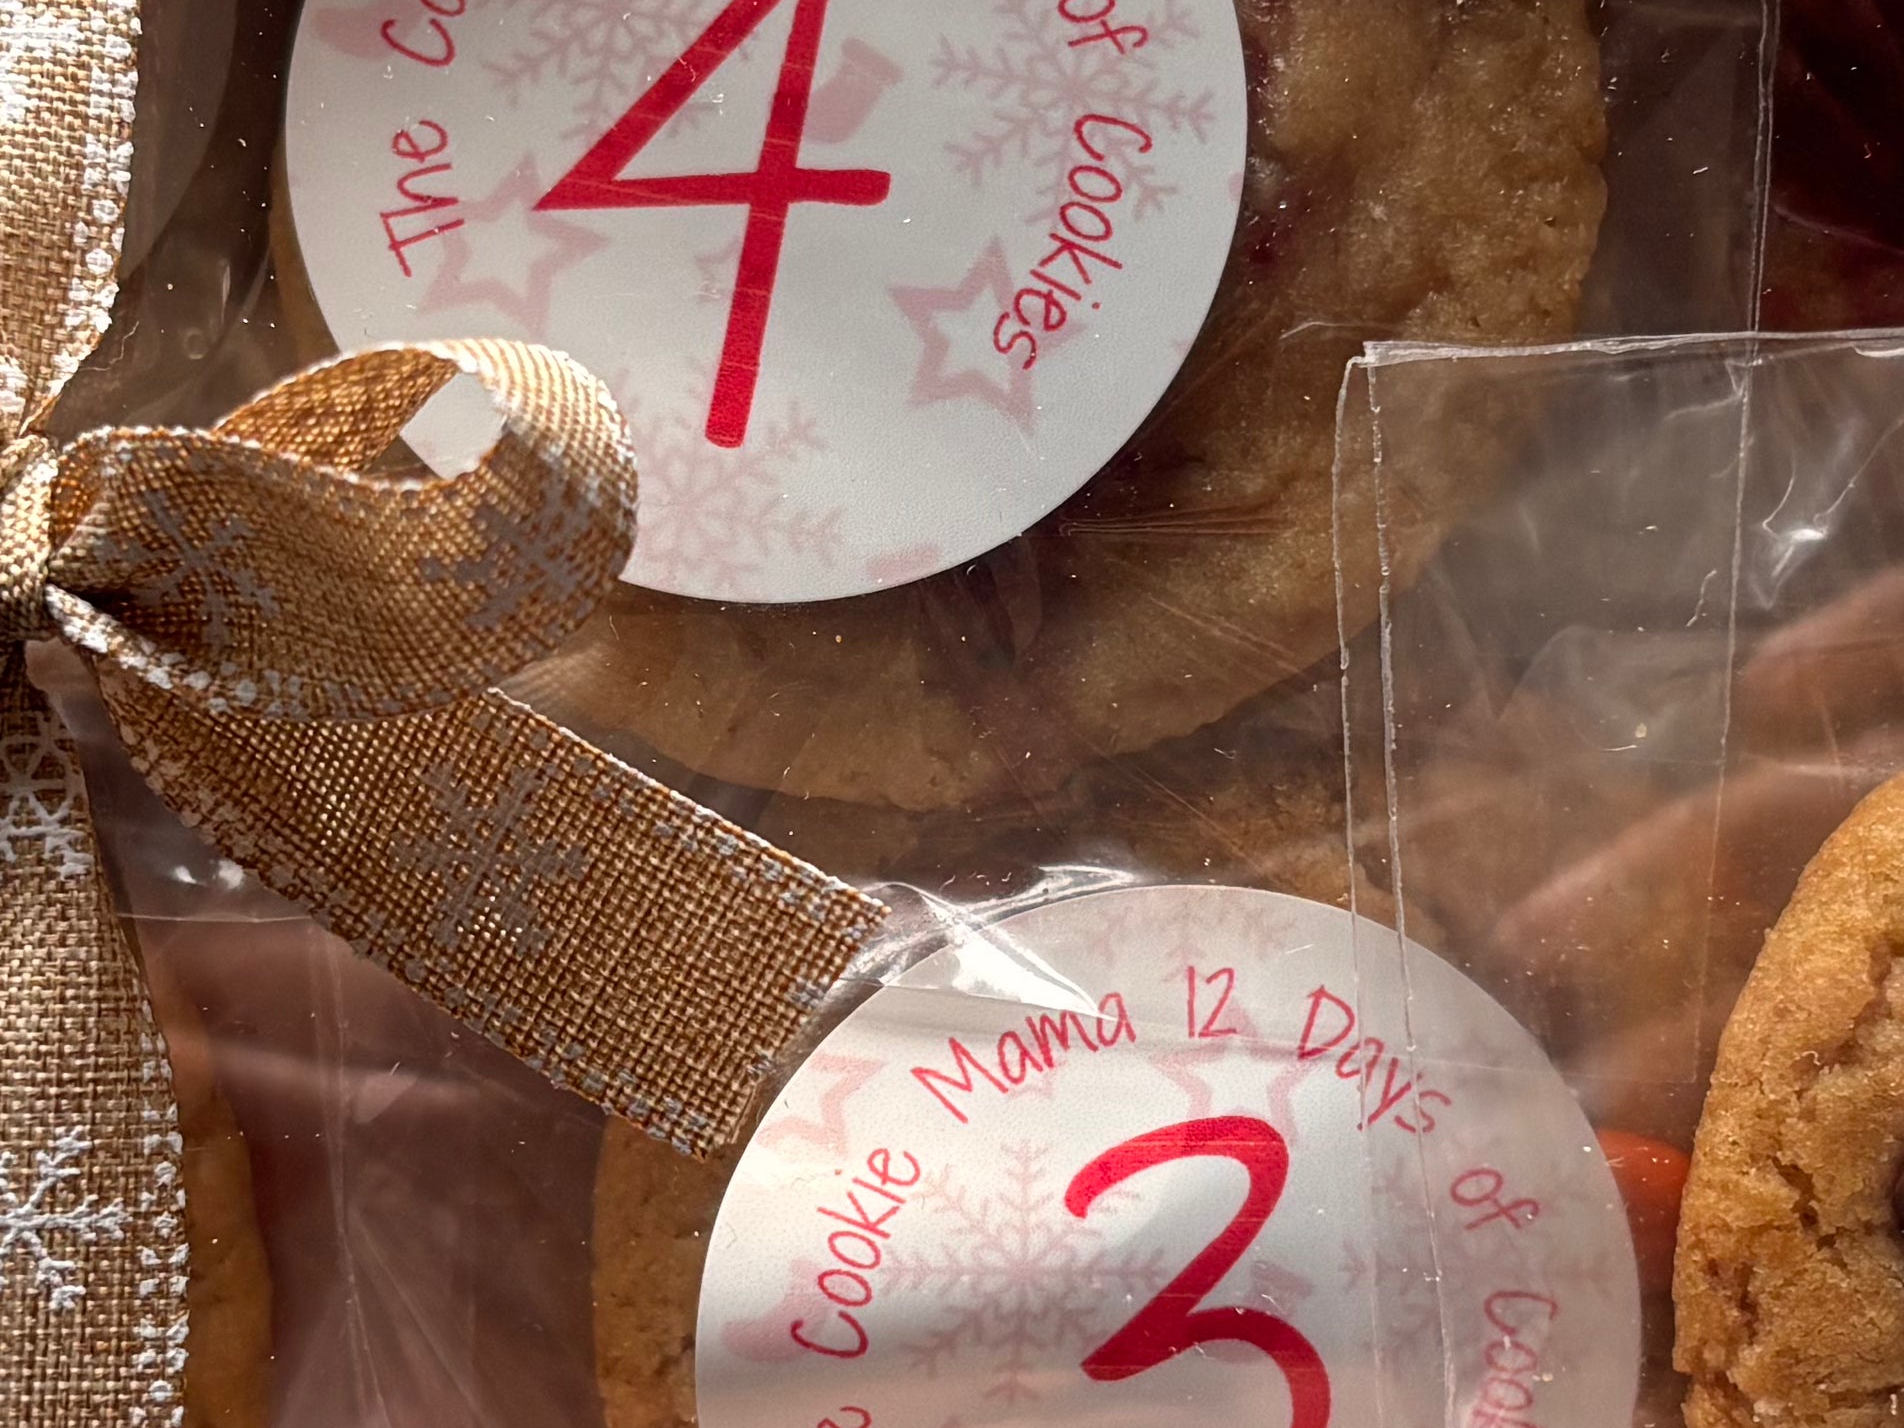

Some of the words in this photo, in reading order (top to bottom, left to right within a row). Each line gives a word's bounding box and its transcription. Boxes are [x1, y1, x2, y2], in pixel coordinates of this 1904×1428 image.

[381, 120, 465, 277] The
[993, 113, 1151, 371] Cookies
[790, 1145, 922, 1359] Cookie
[910, 991, 1134, 1125] Mama
[1186, 965, 1239, 1039] 12
[1297, 985, 1453, 1136] Days
[1450, 1169, 1540, 1232] of
